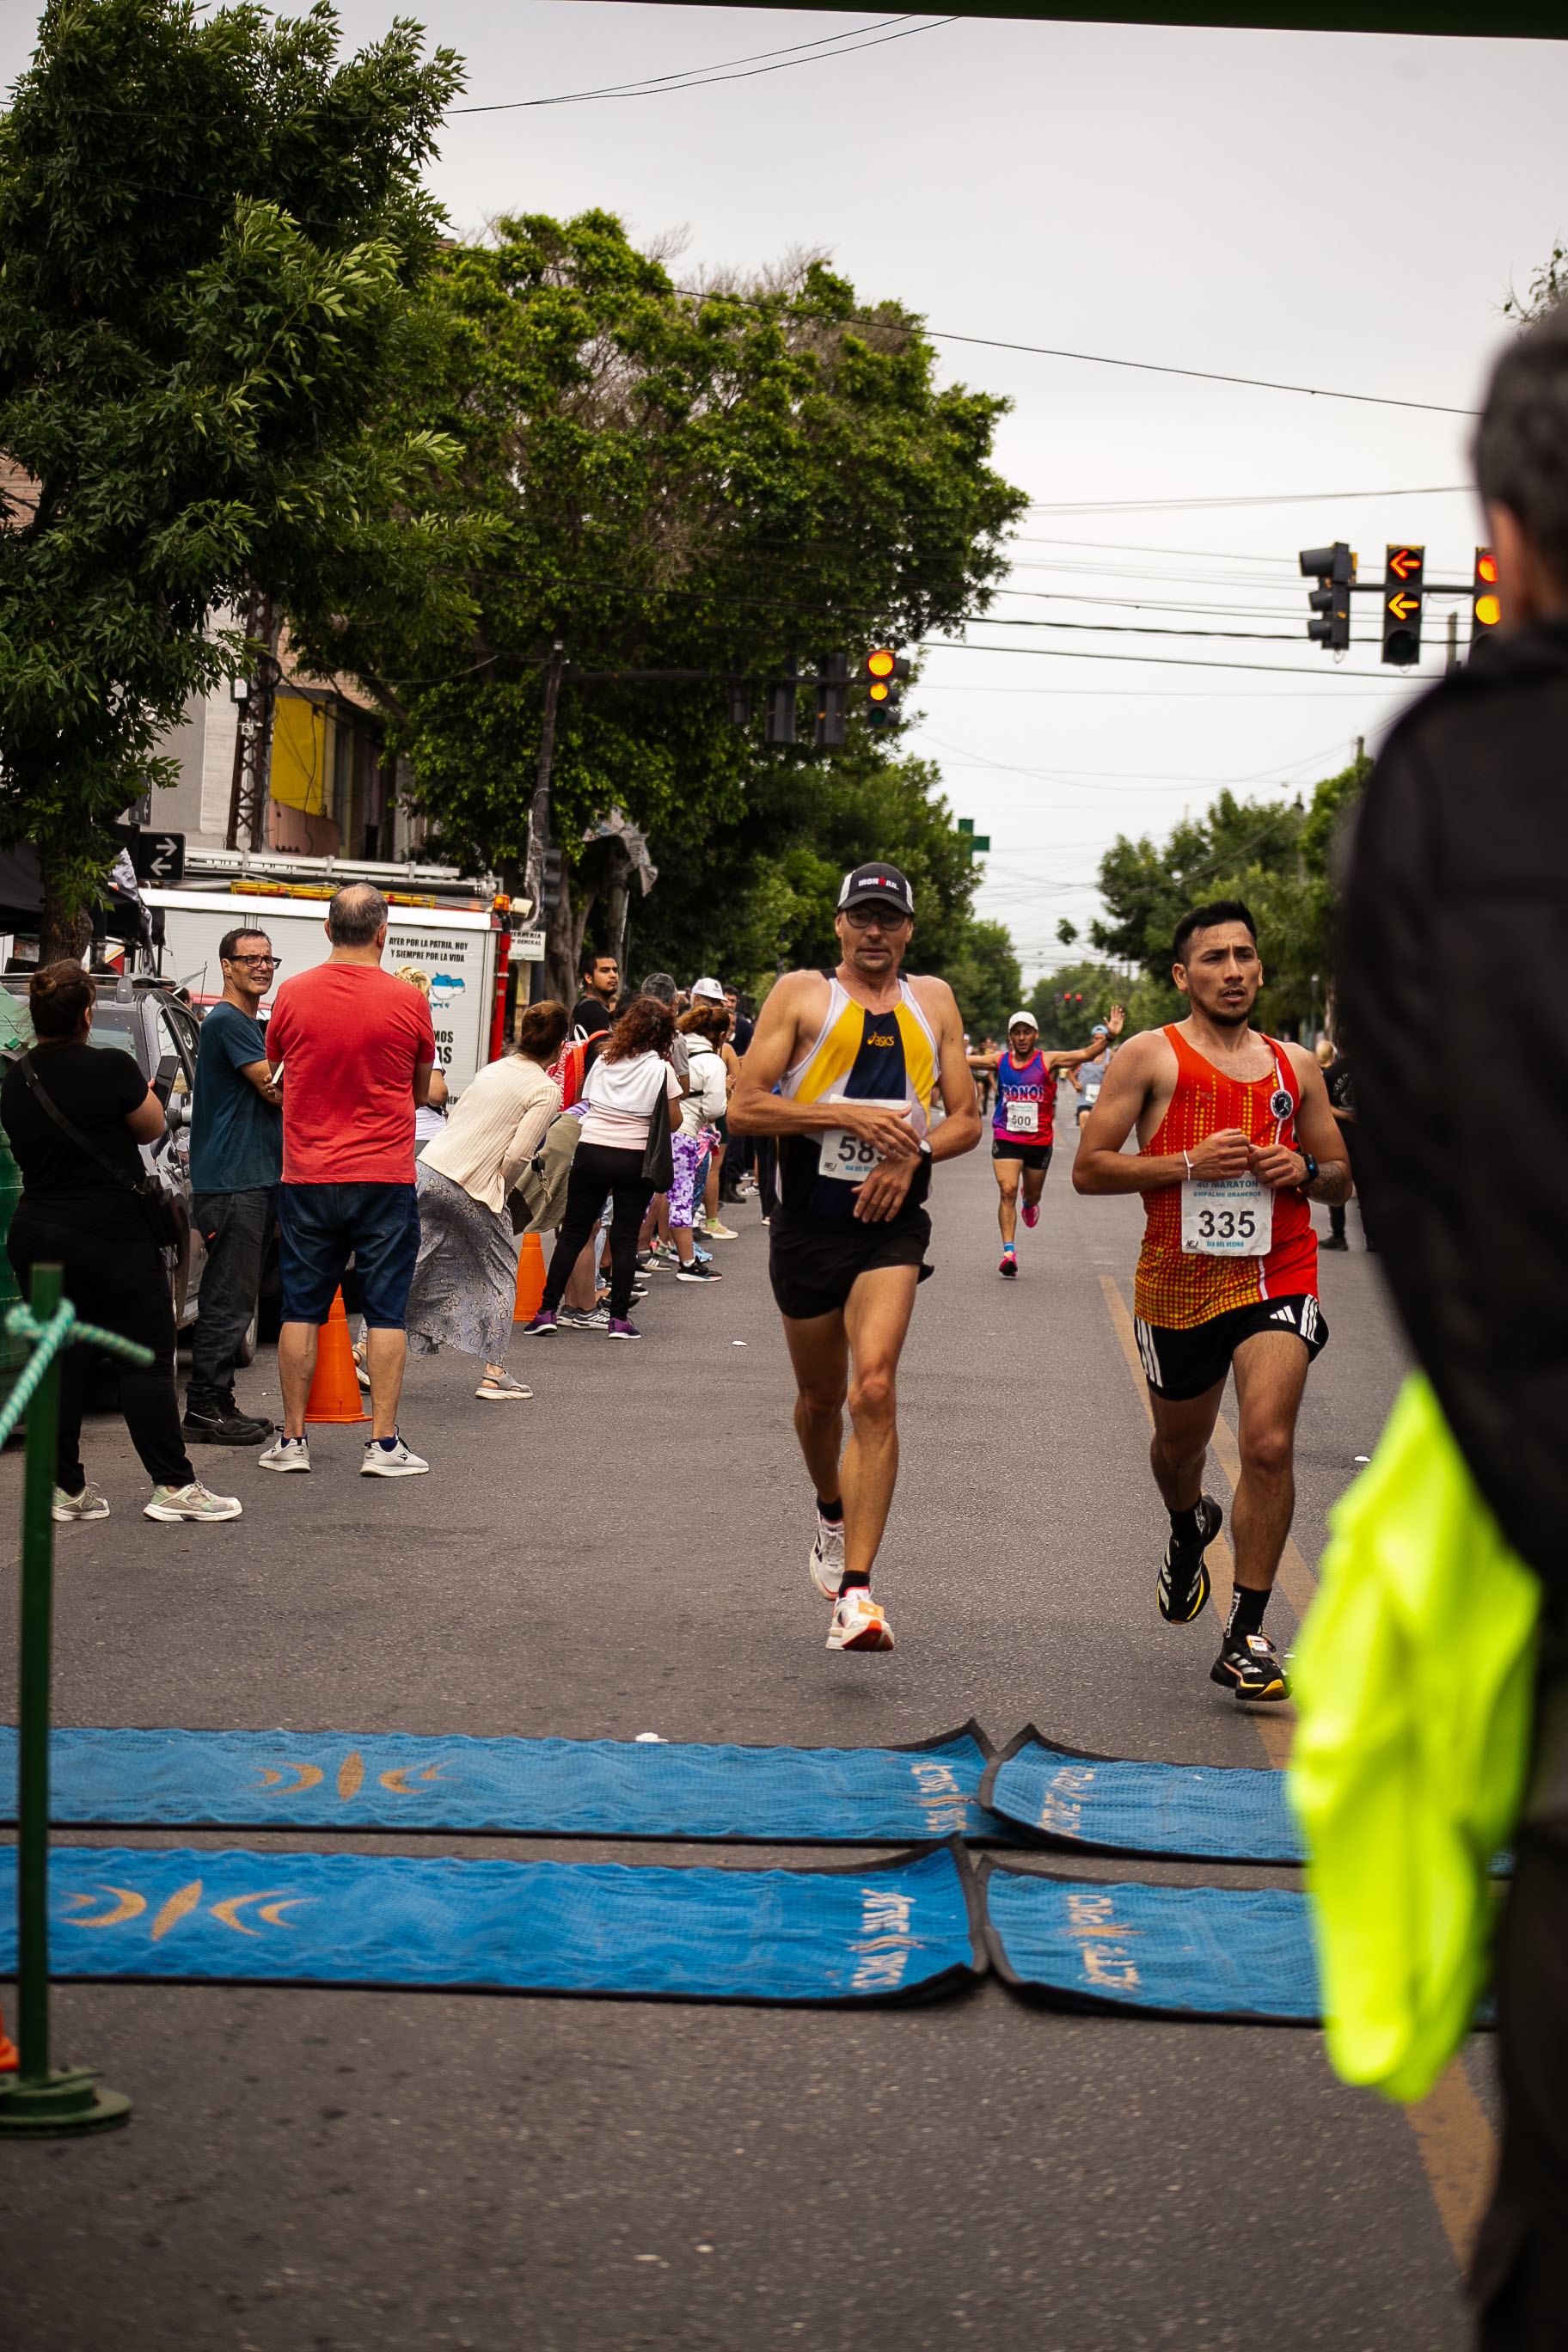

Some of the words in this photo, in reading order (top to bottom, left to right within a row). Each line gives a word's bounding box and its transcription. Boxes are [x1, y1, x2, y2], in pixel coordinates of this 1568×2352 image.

[389, 937, 404, 946] AYER
[407, 938, 419, 946] POR
[430, 940, 454, 950] PATRIA,
[391, 949, 395, 958] Y
[396, 950, 424, 959] SIEMPRE
[426, 952, 438, 960] POR
[450, 953, 465, 963] VIDA
[837, 1136, 887, 1163] 58
[1198, 1210, 1255, 1238] 335
